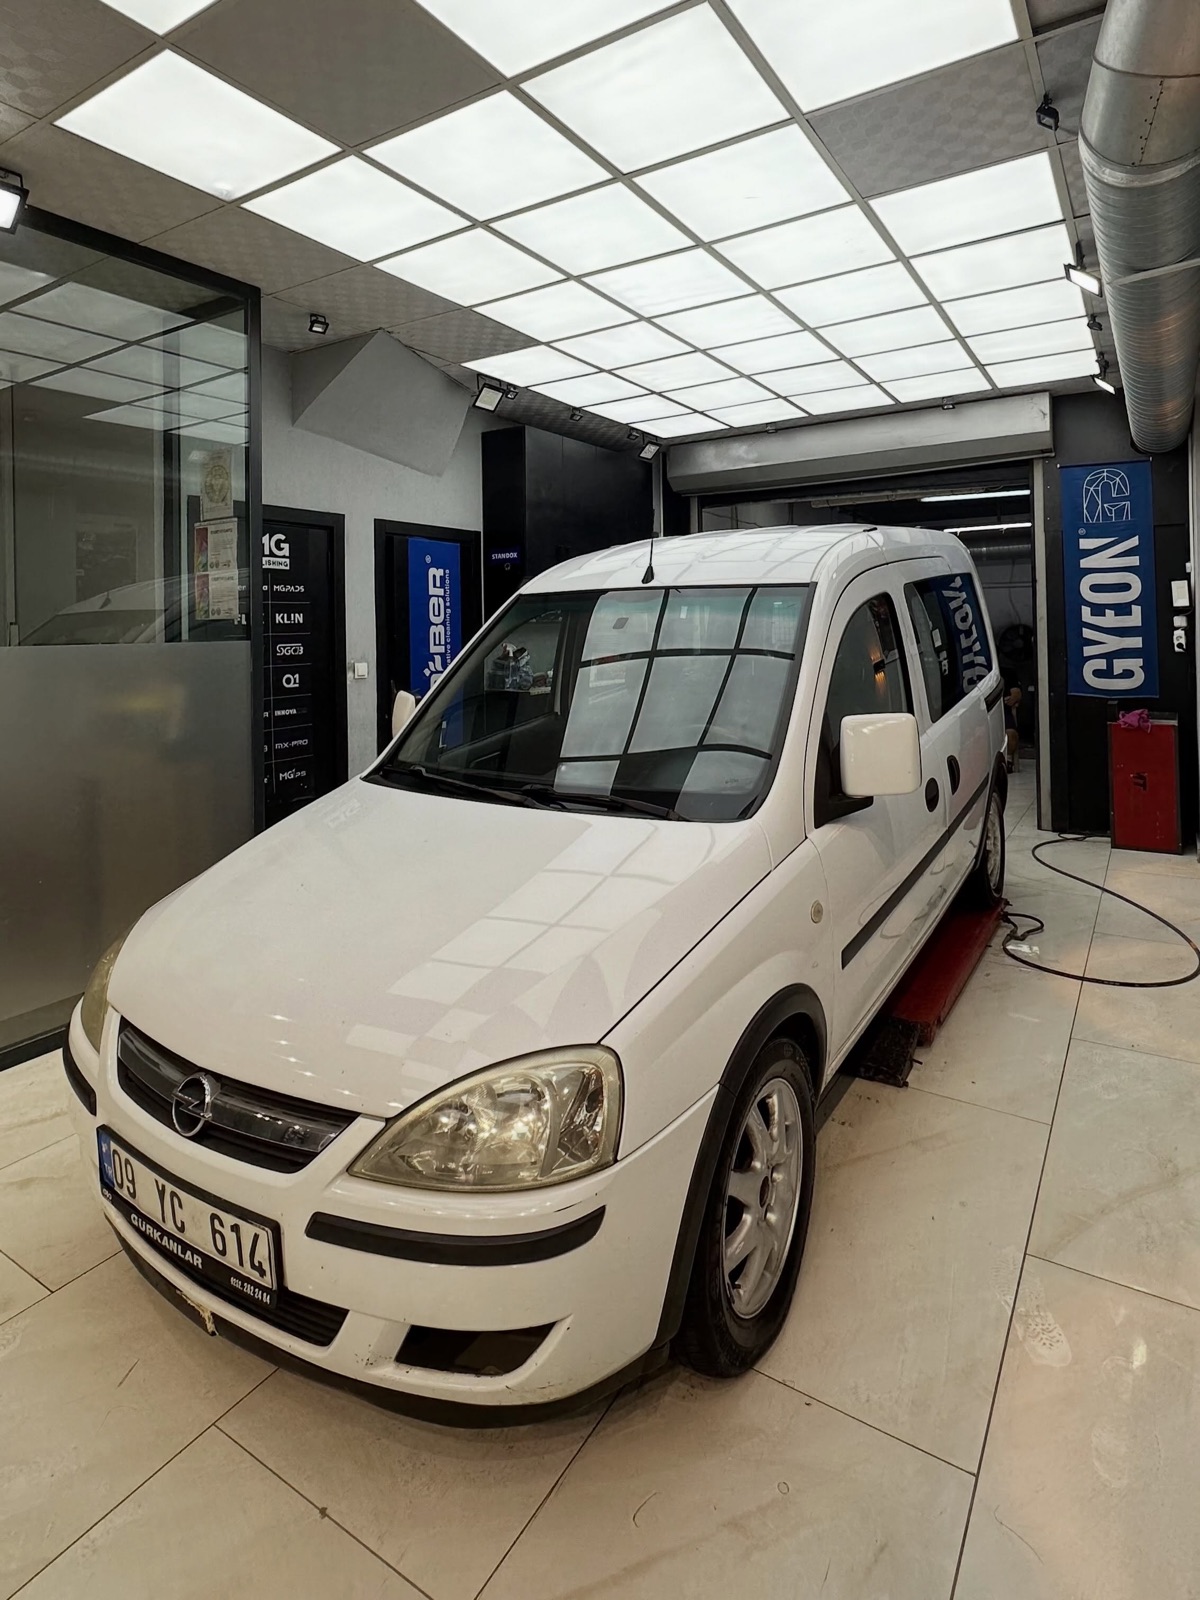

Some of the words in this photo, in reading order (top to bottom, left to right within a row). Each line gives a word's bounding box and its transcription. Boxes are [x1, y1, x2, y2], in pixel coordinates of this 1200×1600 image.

[491, 552, 518, 560] STANDOX
[1078, 535, 1146, 691] GYEON
[103, 1163, 113, 1180] TR
[111, 1148, 137, 1200] 09
[154, 1178, 186, 1235] YC
[209, 1212, 267, 1279] 614
